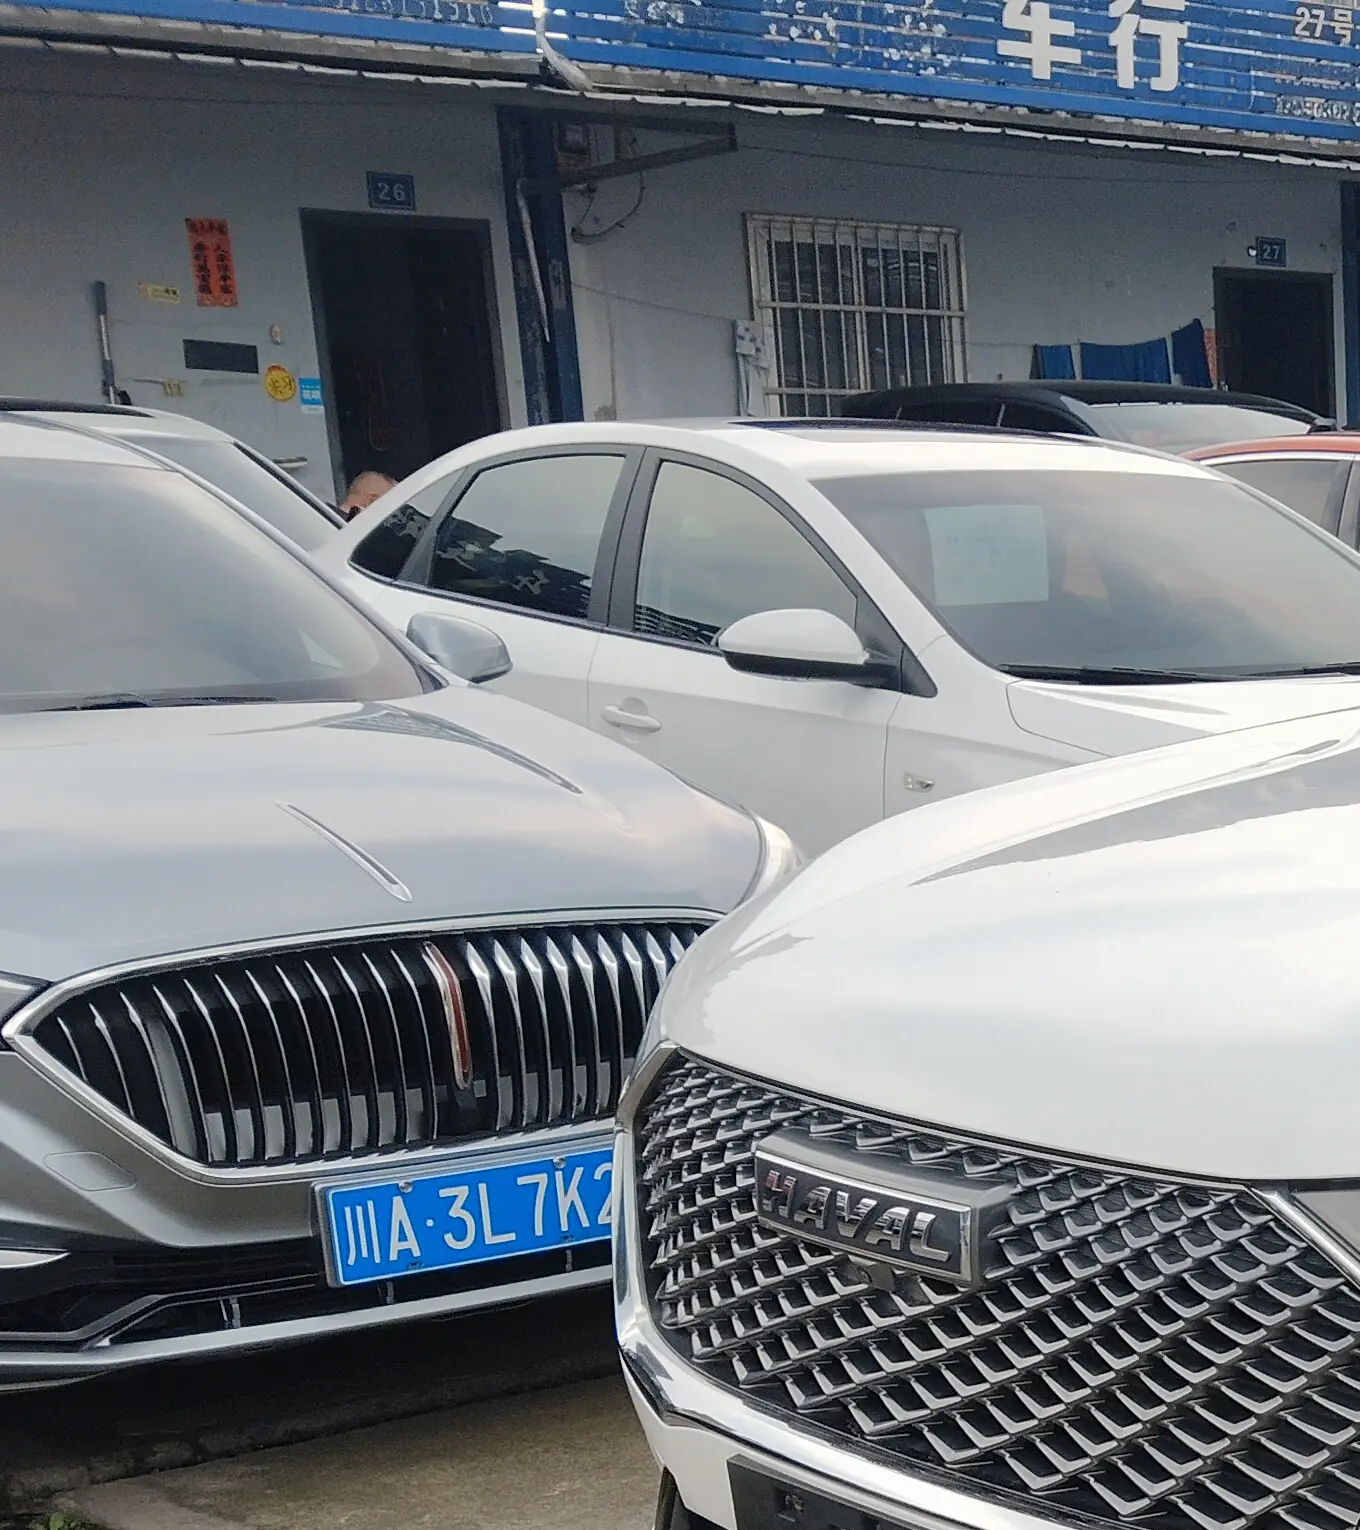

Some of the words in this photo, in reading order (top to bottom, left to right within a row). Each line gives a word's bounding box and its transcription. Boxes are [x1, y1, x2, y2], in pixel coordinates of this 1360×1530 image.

[1295, 7, 1355, 45] 27号
[377, 182, 405, 201] 26
[1262, 243, 1280, 260] 27
[762, 1169, 950, 1262] HAVAL
